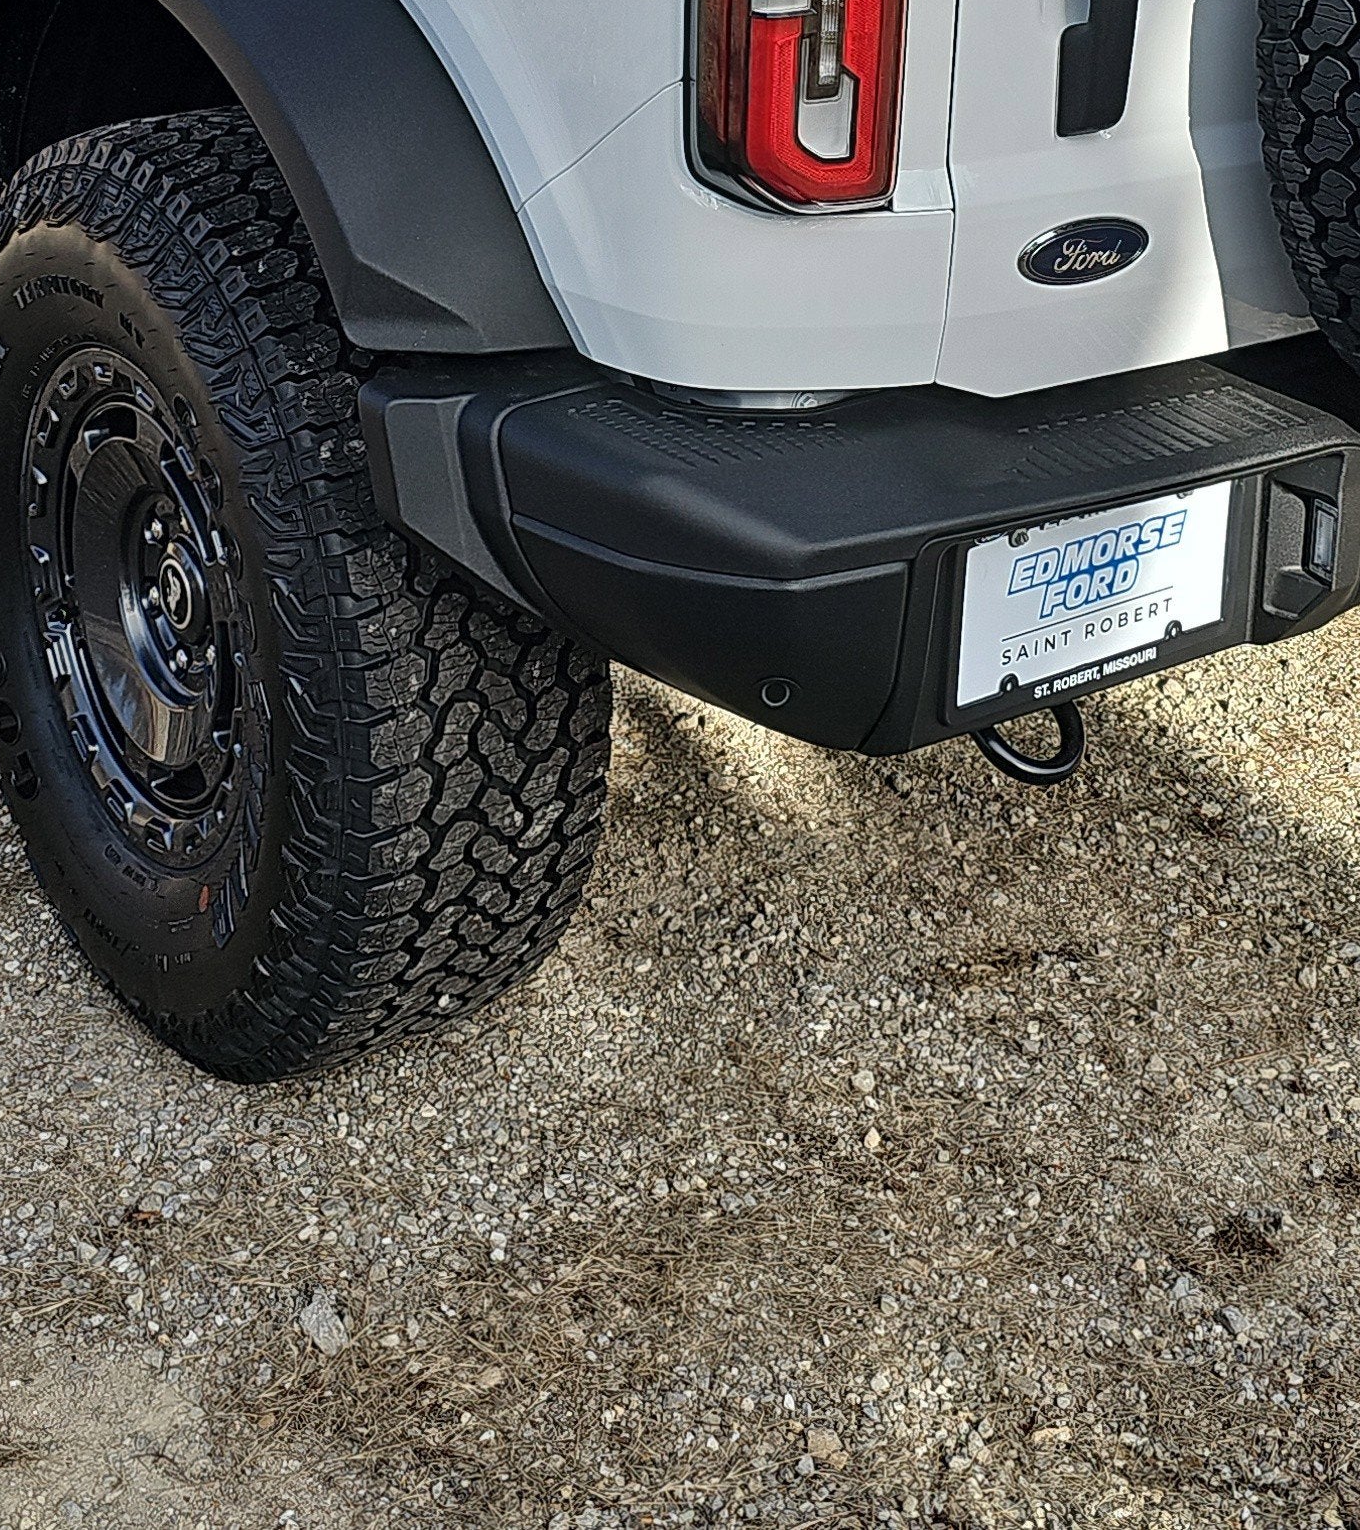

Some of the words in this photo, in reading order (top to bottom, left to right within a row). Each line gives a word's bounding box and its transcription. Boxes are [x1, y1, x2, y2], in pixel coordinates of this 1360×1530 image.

[1053, 236, 1123, 273] Ford
[1007, 547, 1061, 597] ED
[1059, 509, 1187, 579] MORSE
[1039, 557, 1139, 620] FORD
[1001, 630, 1072, 666] SAINT
[1084, 597, 1173, 640] ROBERT
[1033, 682, 1051, 699] ST.
[1052, 665, 1101, 694] ROBERT,
[1102, 646, 1157, 674] MISSOURI
